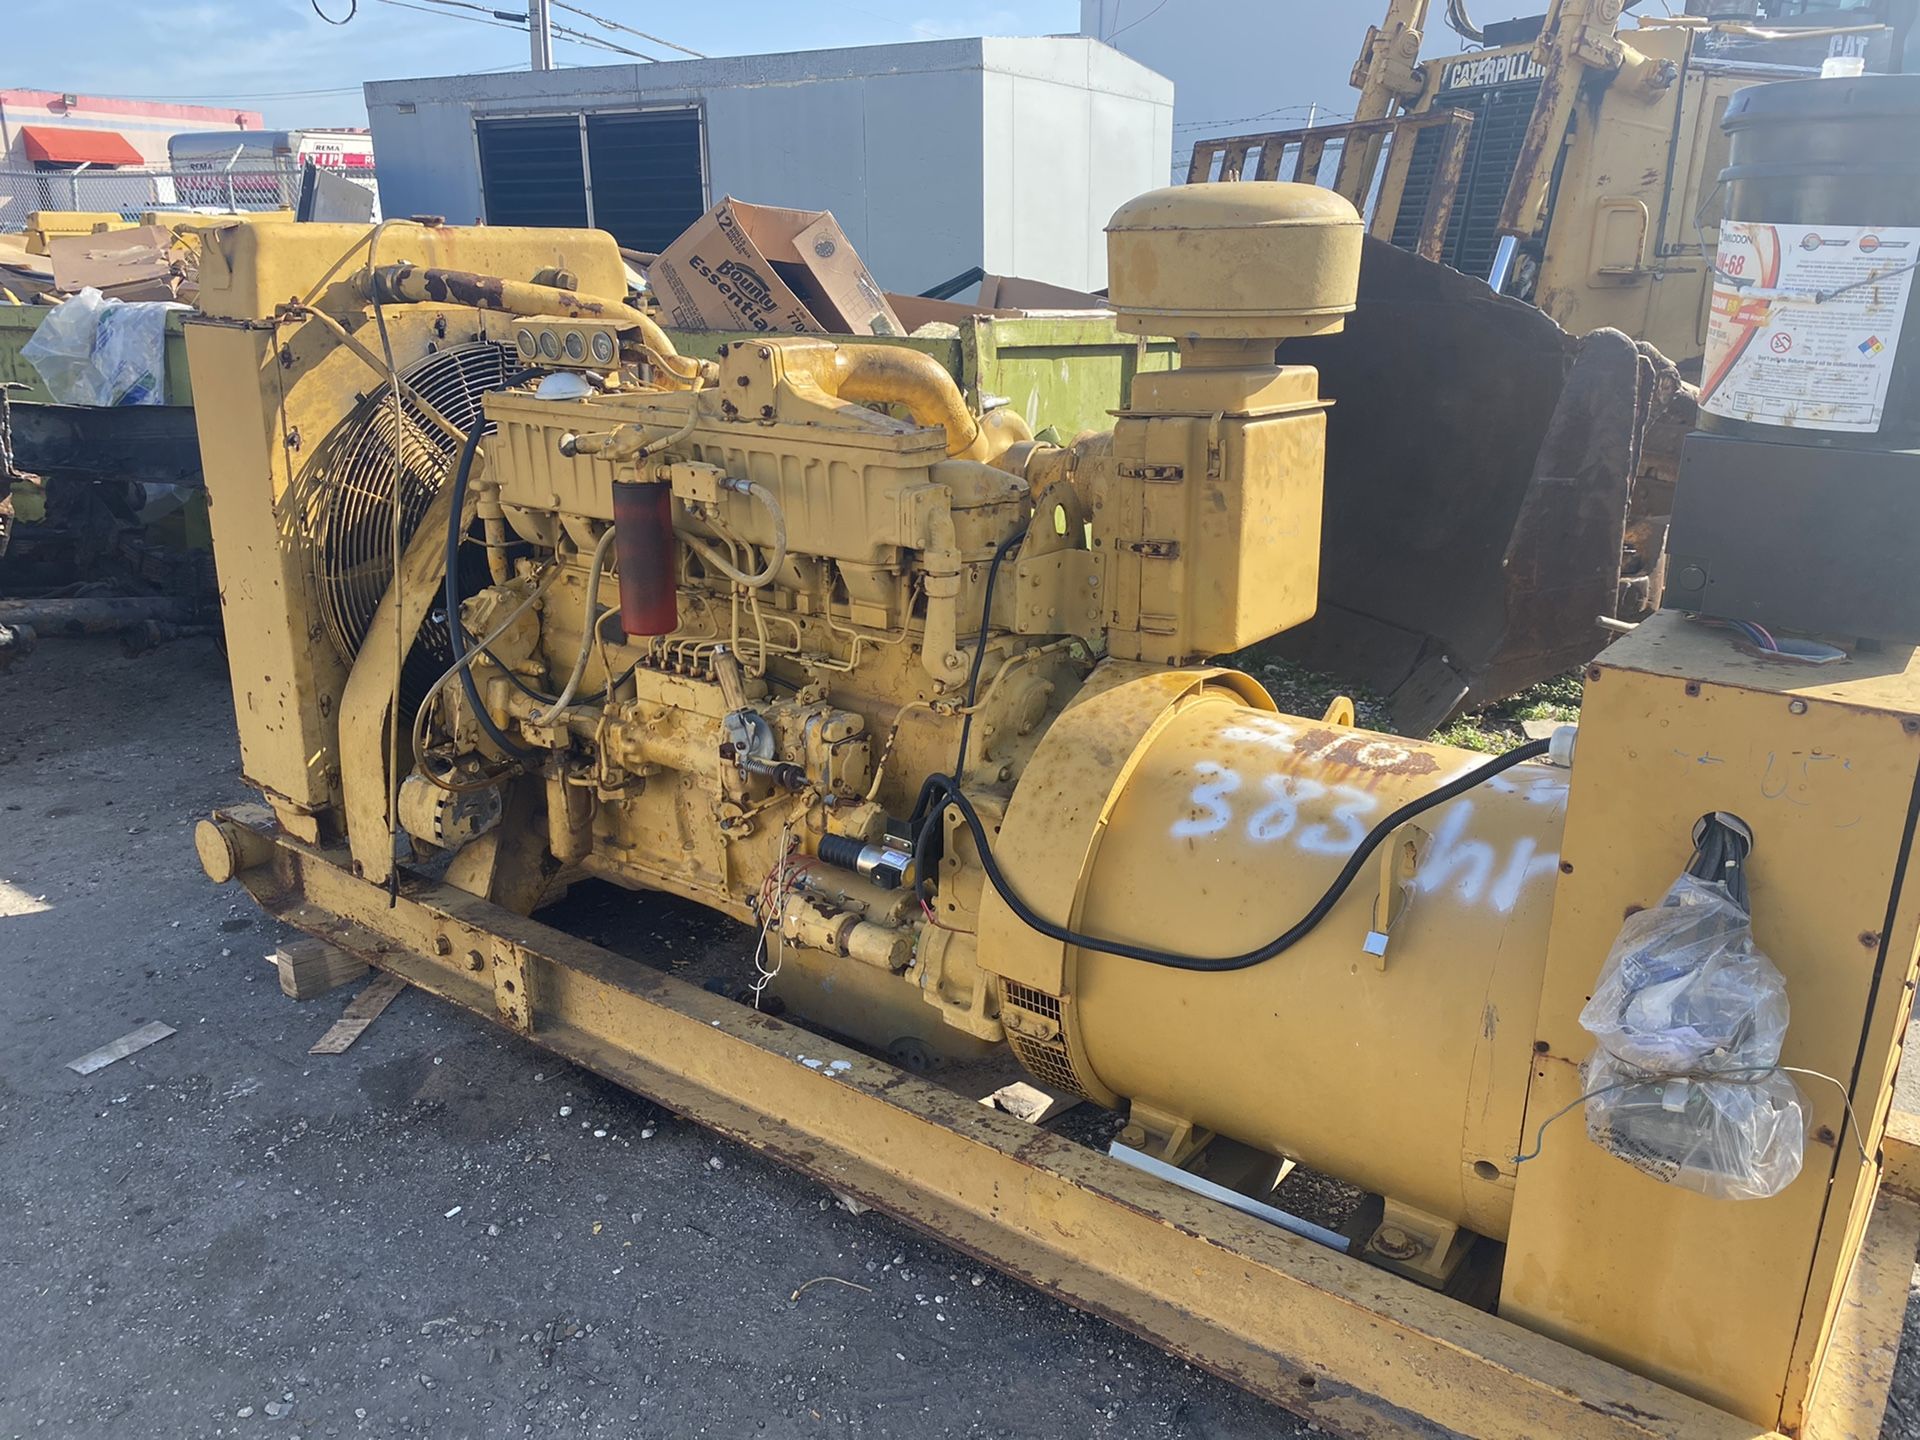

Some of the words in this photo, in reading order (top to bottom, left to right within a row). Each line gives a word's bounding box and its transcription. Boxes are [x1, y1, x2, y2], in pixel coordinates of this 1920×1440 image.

[1828, 34, 1869, 58] CAT
[314, 144, 341, 153] REMA
[190, 163, 214, 171] REMA
[714, 205, 734, 233] 12
[716, 259, 778, 313] Bounty
[787, 310, 809, 333] 770
